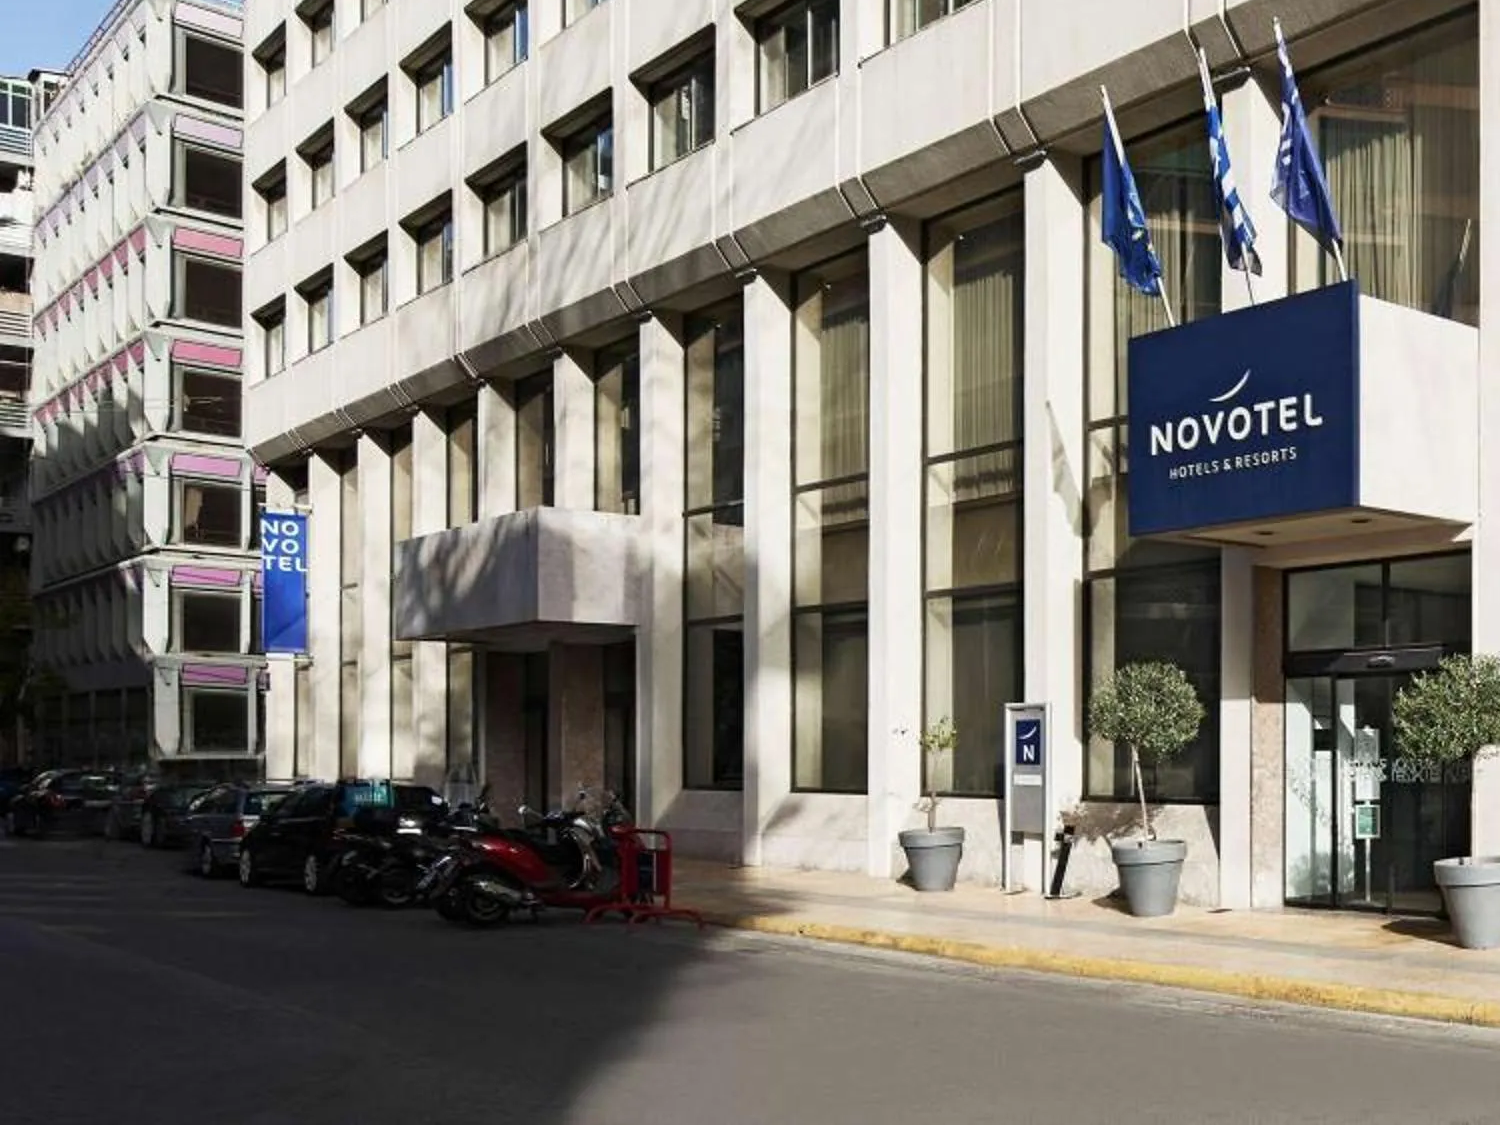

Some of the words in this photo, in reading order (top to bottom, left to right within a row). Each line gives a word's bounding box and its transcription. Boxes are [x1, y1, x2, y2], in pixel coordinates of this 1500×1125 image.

[1150, 393, 1323, 456] NOVOTEL
[1169, 460, 1219, 480] HOTELS
[1223, 457, 1232, 471] &
[1235, 446, 1298, 469] RESORTS
[260, 519, 299, 536] NO
[262, 537, 299, 555] VO
[263, 555, 308, 572] TEL
[1023, 744, 1035, 762] N
